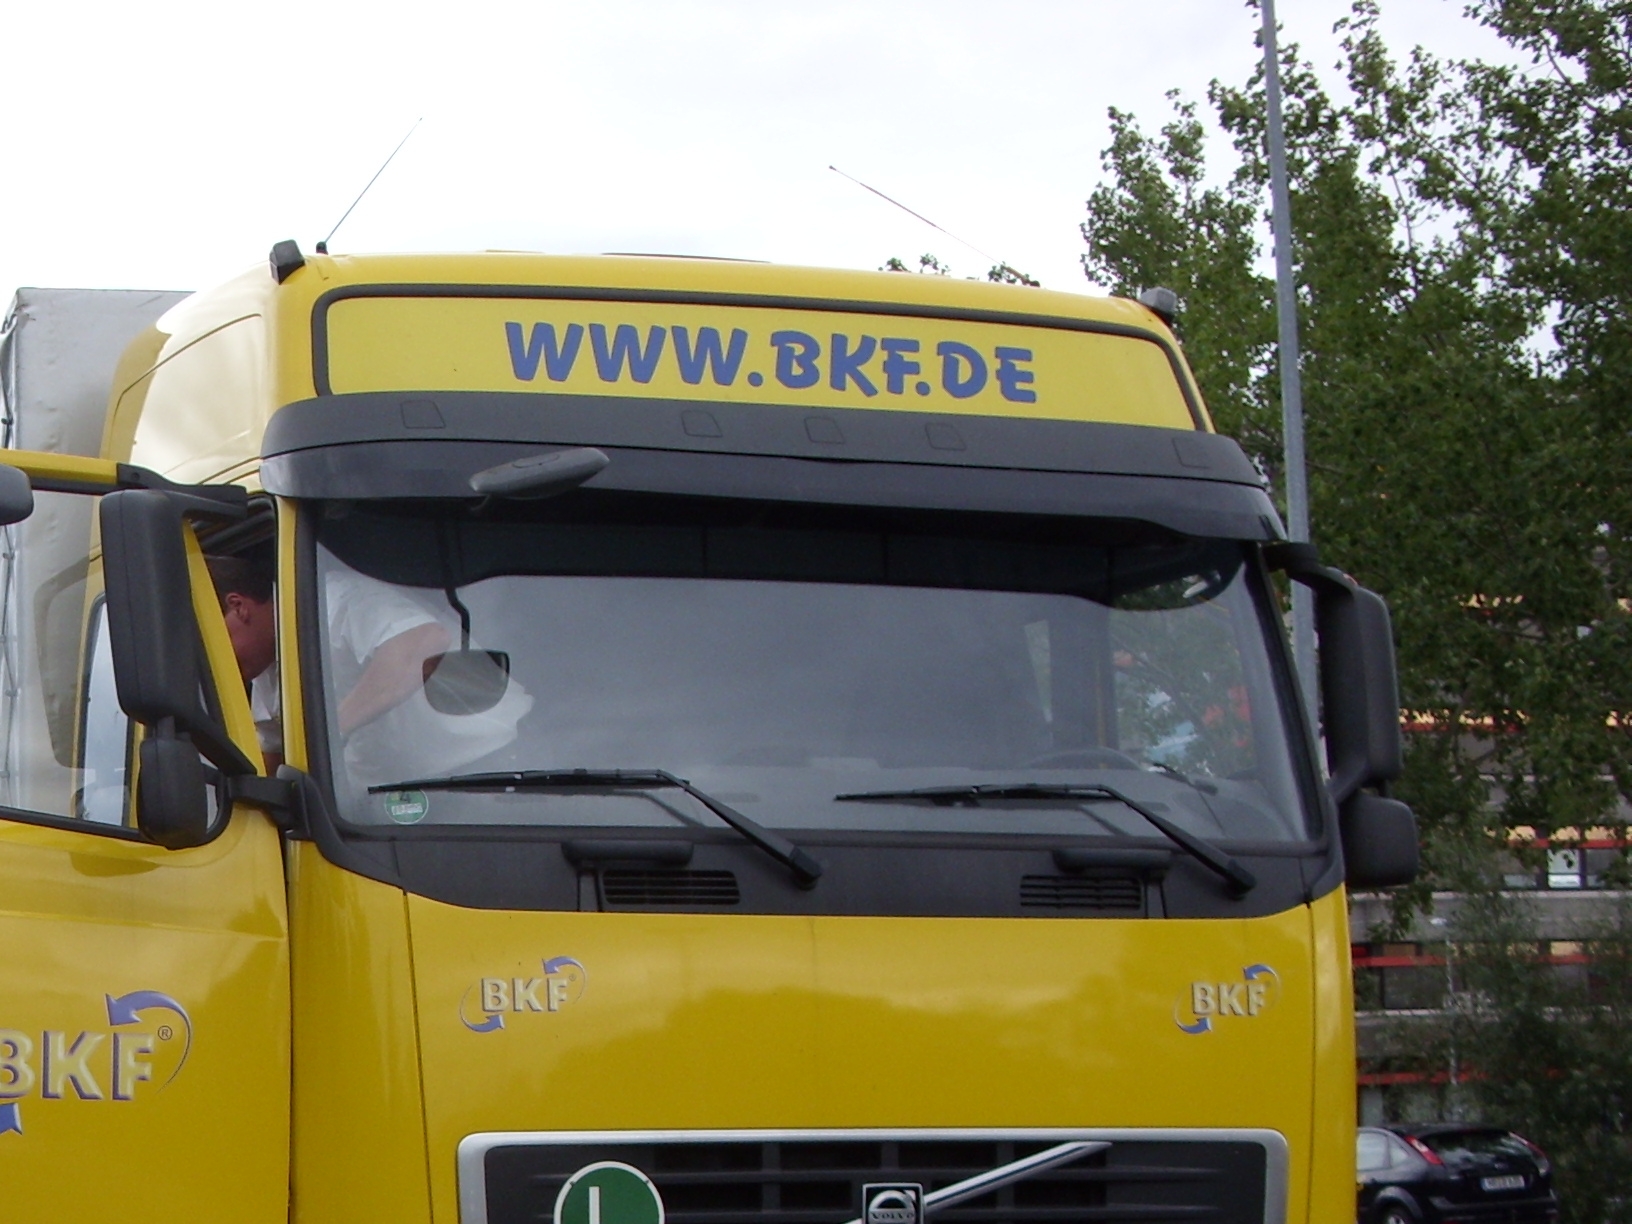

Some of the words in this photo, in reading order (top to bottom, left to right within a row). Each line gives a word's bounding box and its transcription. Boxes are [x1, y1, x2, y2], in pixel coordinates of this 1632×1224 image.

[505, 321, 1037, 403] WWW.BKF.DE
[481, 977, 568, 1012] BKF
[1192, 982, 1266, 1016] BKF
